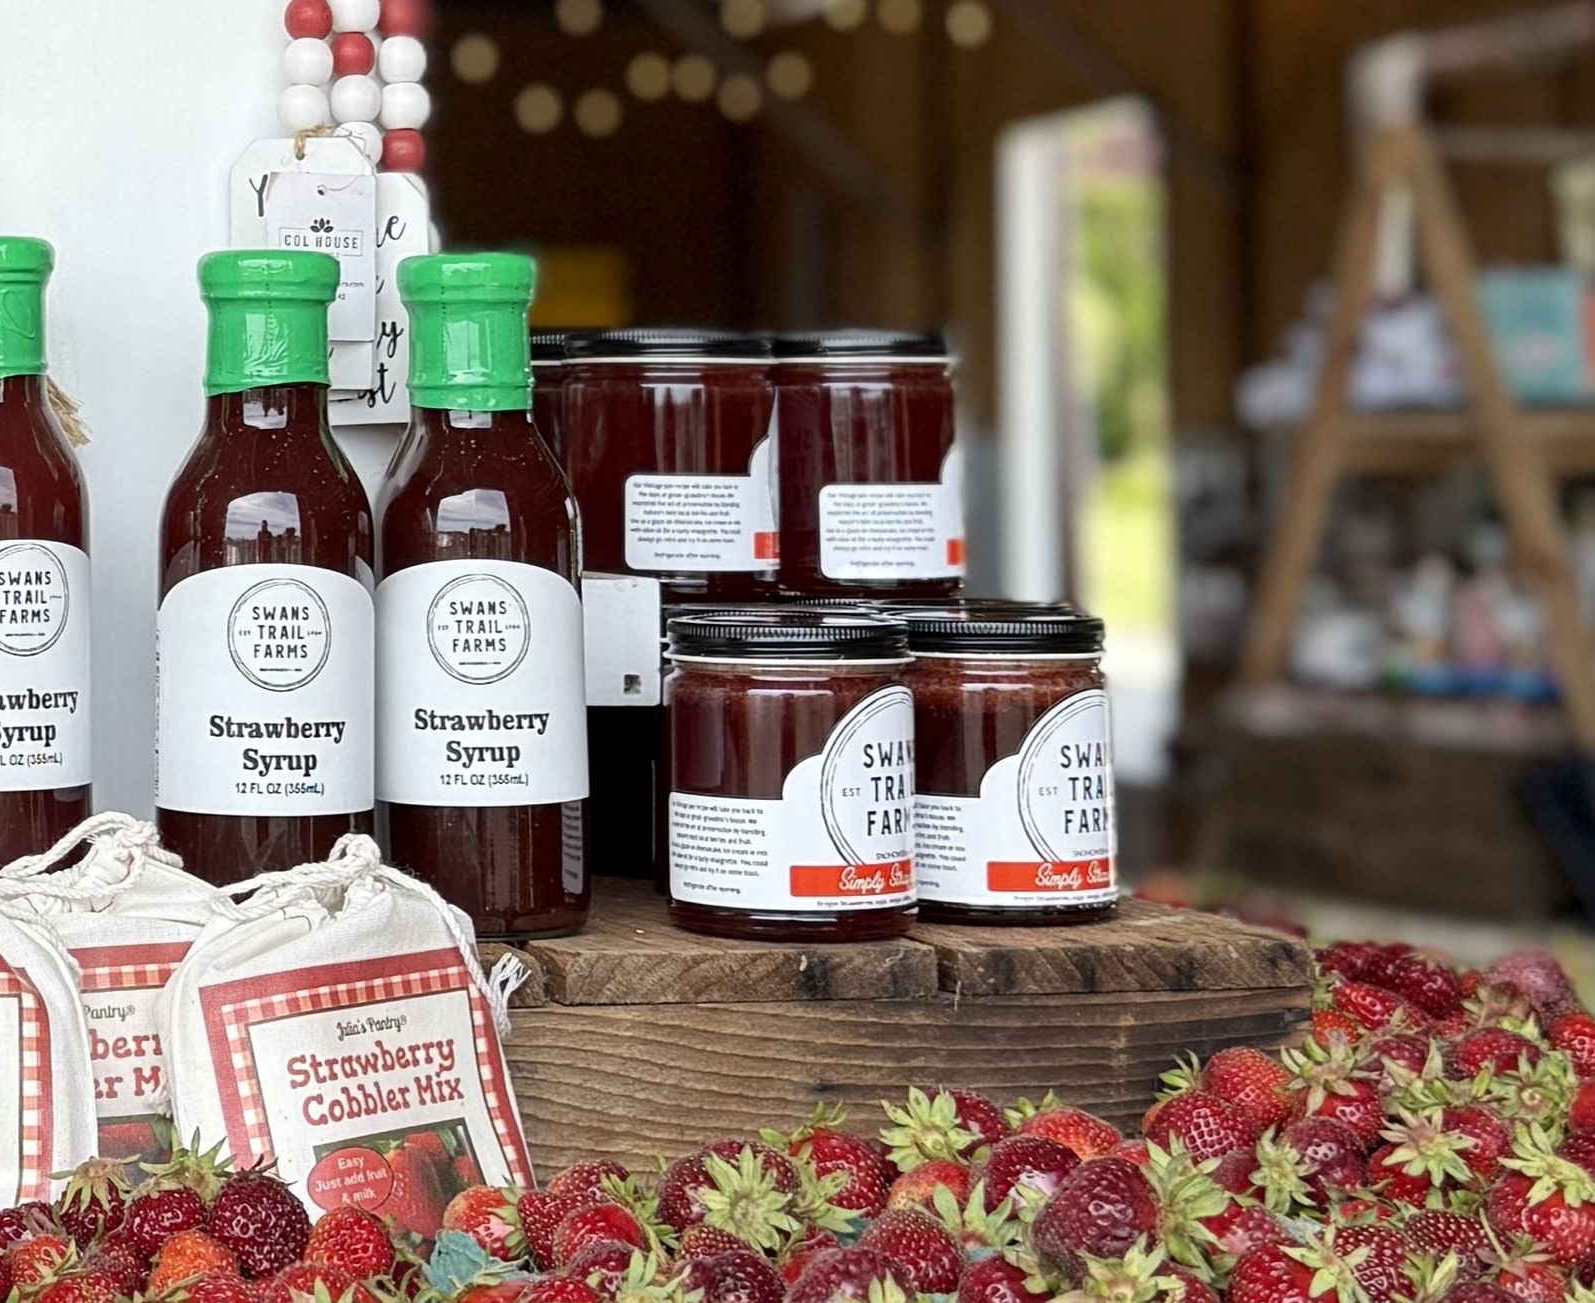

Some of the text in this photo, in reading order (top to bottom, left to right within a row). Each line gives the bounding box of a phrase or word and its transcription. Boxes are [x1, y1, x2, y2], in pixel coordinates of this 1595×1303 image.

[315, 236, 358, 249] HOUSE
[2, 589, 47, 605] TRAIL
[0, 608, 50, 624] FARMS
[252, 606, 309, 621] SWANS
[449, 601, 507, 615] SWANS
[257, 625, 305, 640] TRAIL
[455, 619, 503, 634] TRAIL
[254, 644, 308, 659] FARMS
[453, 638, 506, 653] FARMS
[209, 715, 346, 744] Strawberry
[414, 708, 550, 735] Strawberry
[9, 754, 24, 766] OZ
[243, 748, 318, 777] Syrup
[446, 740, 521, 769] Syrup
[1060, 742, 1106, 768] SWA
[440, 774, 452, 785] 12
[455, 774, 468, 785] FL
[471, 774, 485, 785] OZ
[236, 783, 247, 794] 12
[250, 783, 264, 795] FL
[267, 783, 282, 794] OZ
[838, 866, 885, 894] Simply
[1034, 862, 1083, 890] Simply
[336, 1018, 367, 1041] Julia's
[286, 1038, 455, 1090] Strawberry
[302, 1071, 465, 1126] Cobbler Mix
[337, 1156, 364, 1170] Easy
[315, 1167, 388, 1192] Just add fruit
[353, 1187, 377, 1202] milk
